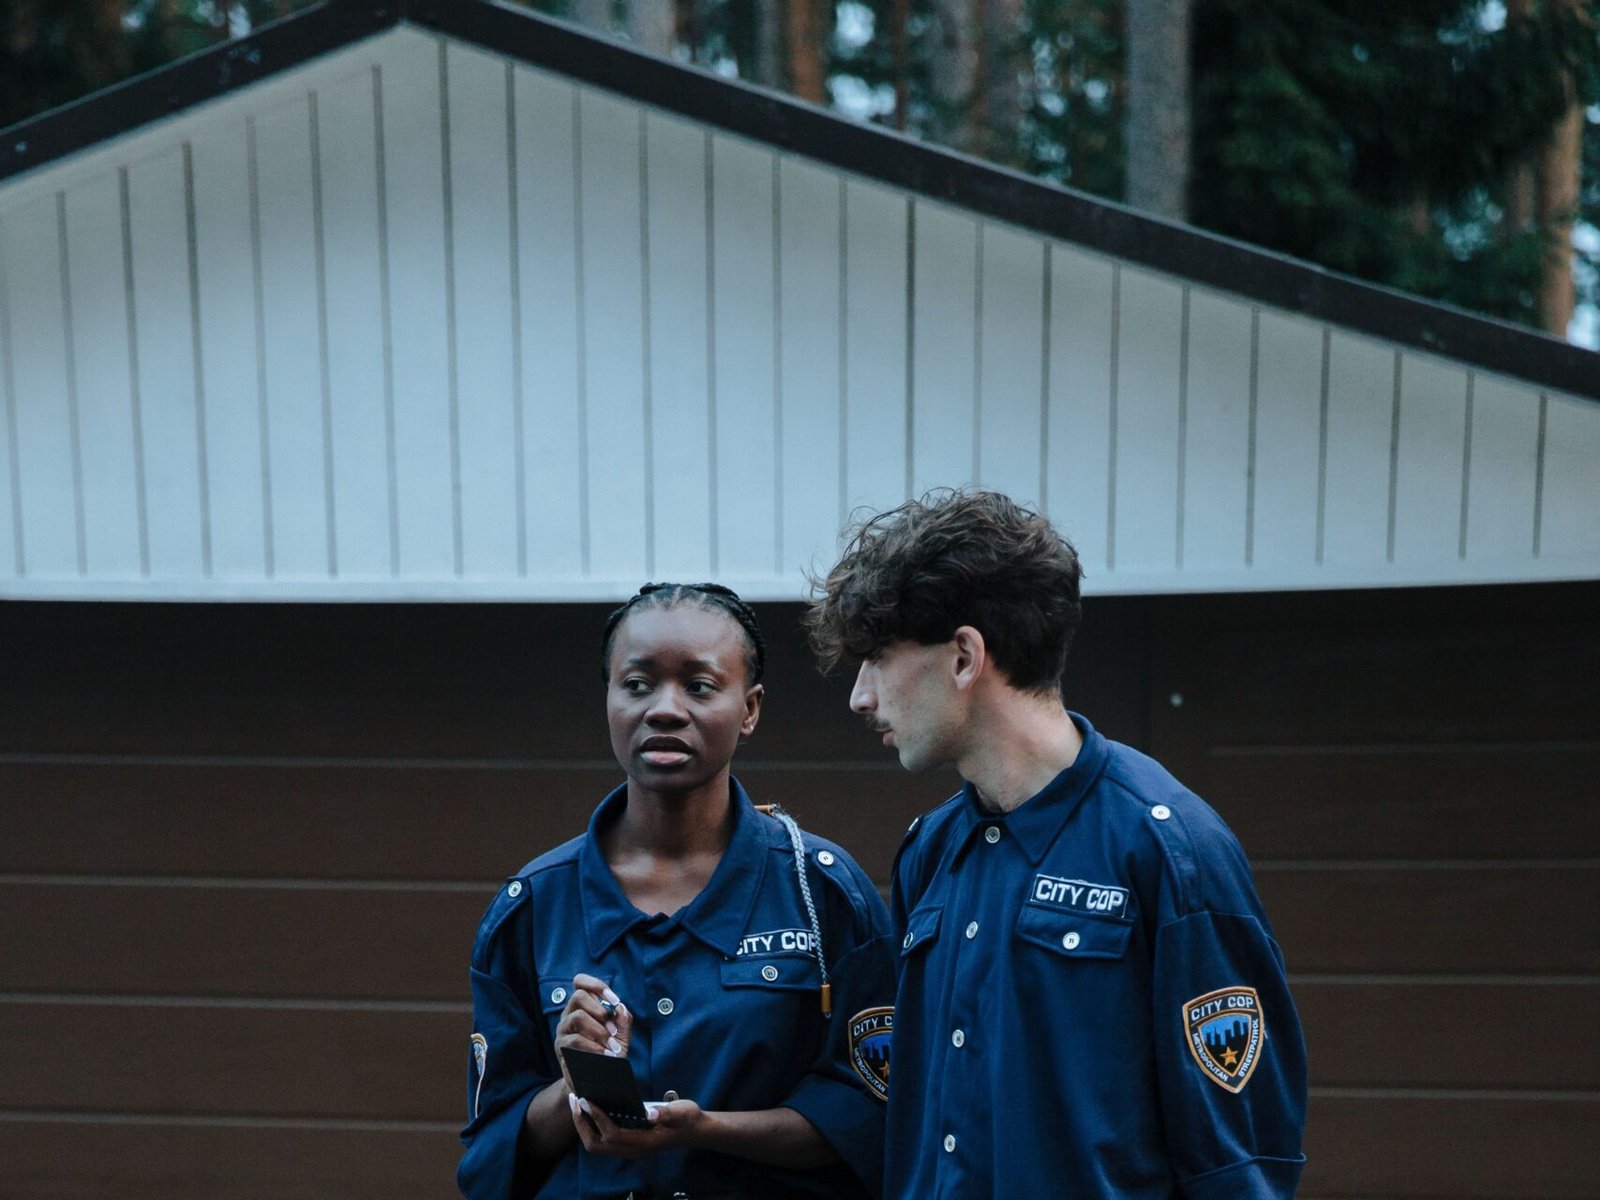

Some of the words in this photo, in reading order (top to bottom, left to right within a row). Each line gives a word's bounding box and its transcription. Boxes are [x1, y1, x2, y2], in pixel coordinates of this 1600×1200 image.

[1035, 879, 1084, 906] CITY
[1085, 888, 1124, 911] COP
[781, 931, 817, 952] COP
[1191, 999, 1222, 1021] CITY
[1227, 996, 1254, 1009] COP
[853, 1017, 879, 1037] CITY
[1192, 1032, 1229, 1082] METROPOLITAN
